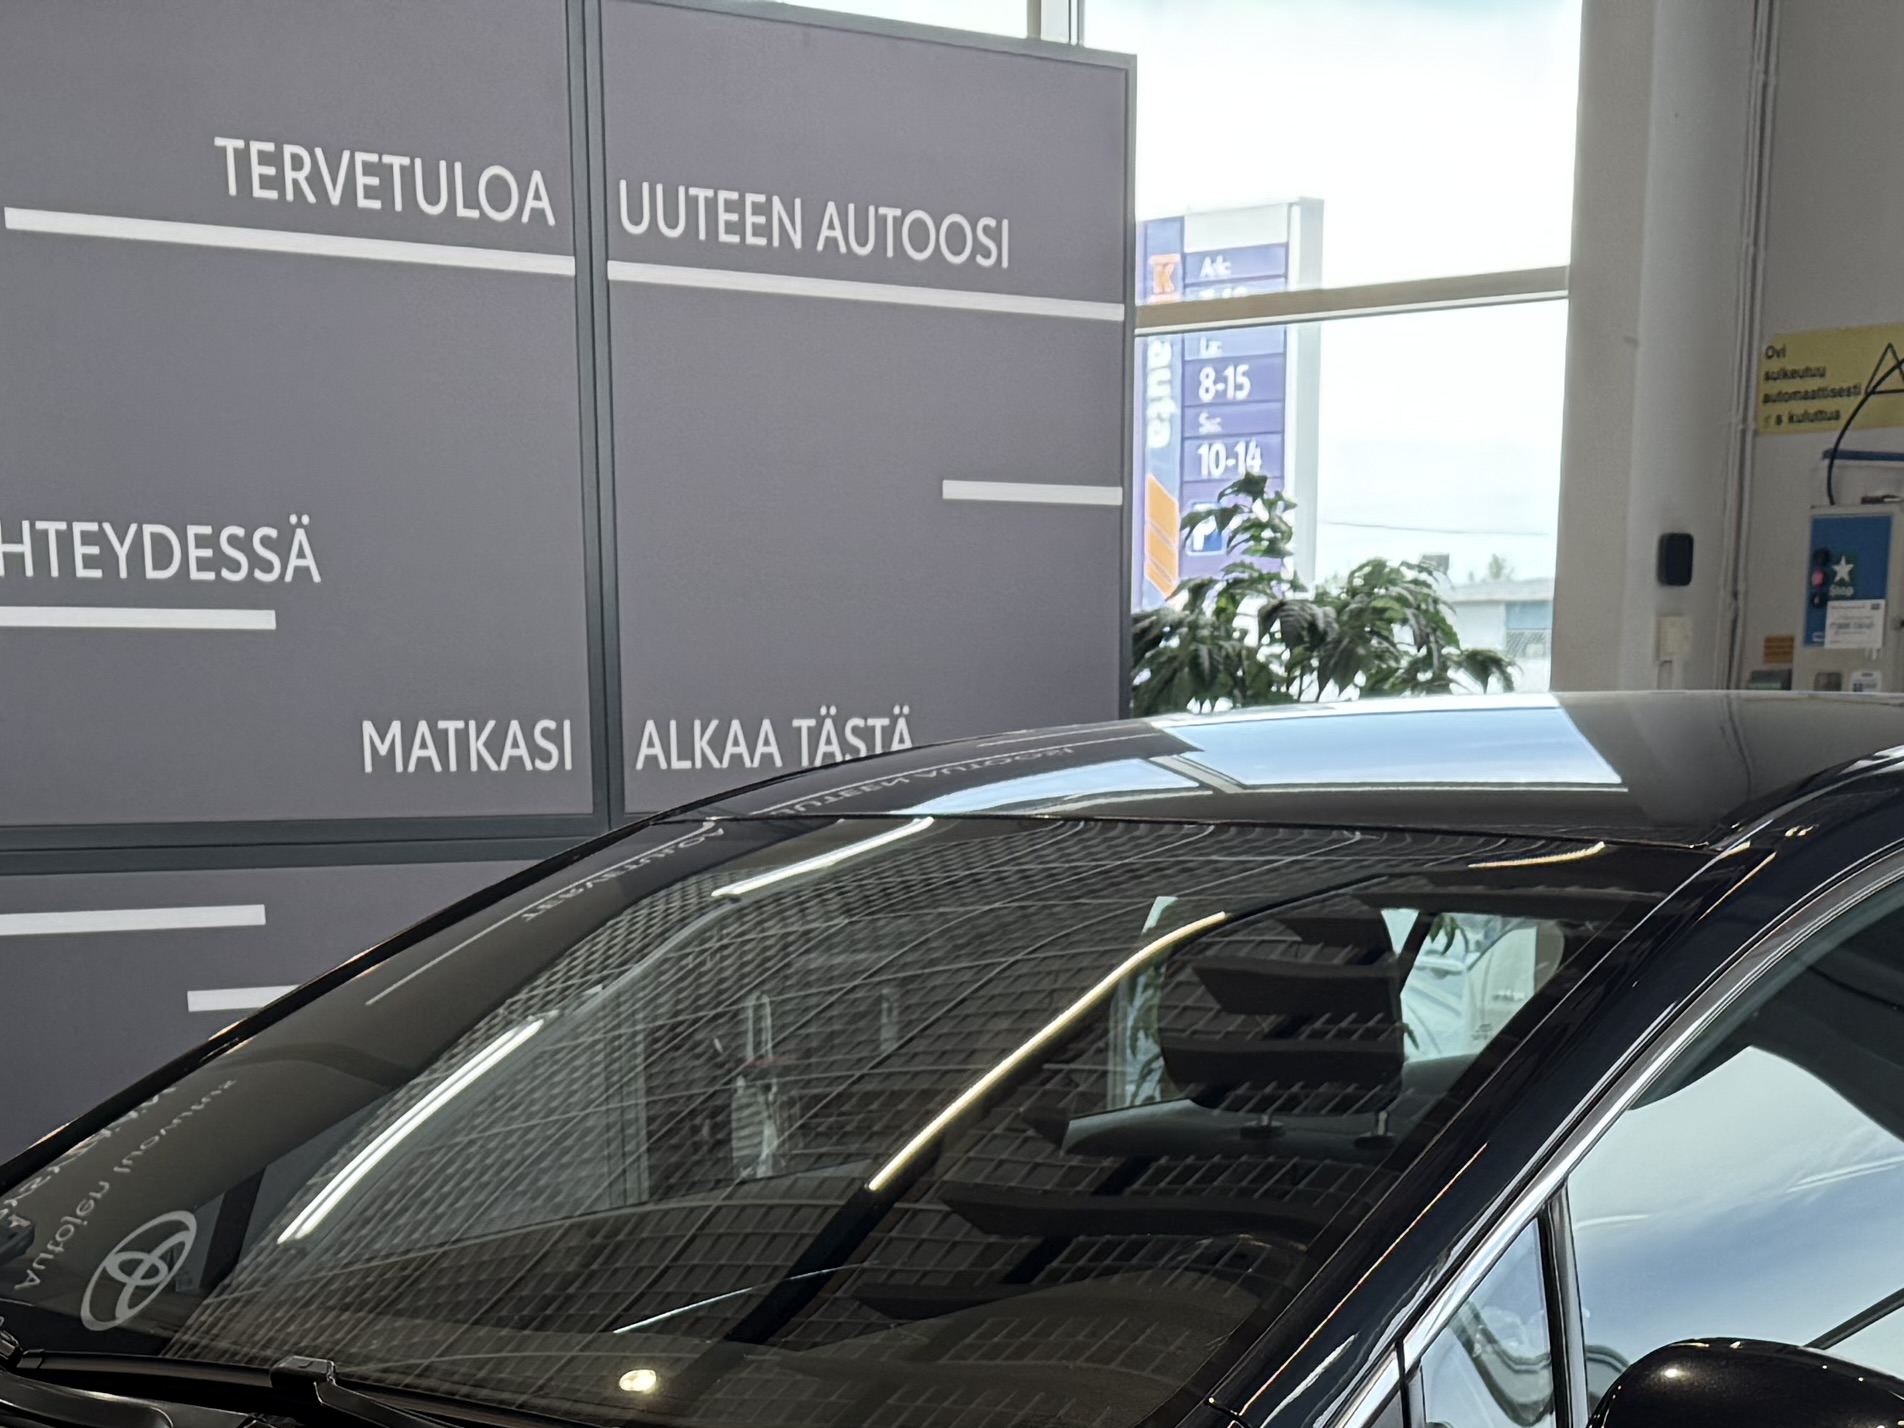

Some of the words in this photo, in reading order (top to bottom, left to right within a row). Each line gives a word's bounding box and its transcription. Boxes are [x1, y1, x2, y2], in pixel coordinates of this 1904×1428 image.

[213, 136, 557, 228] TERVETULOA
[617, 178, 804, 251] UUTEEN
[814, 200, 1011, 271] AUTOOSI
[1764, 345, 1787, 359] Ovi
[1198, 364, 1251, 403] 8-15
[1198, 440, 1263, 478] 10-14
[361, 718, 574, 775] MATKASI
[635, 717, 782, 772] ALKAA
[793, 704, 913, 768] TÄSTÄ
